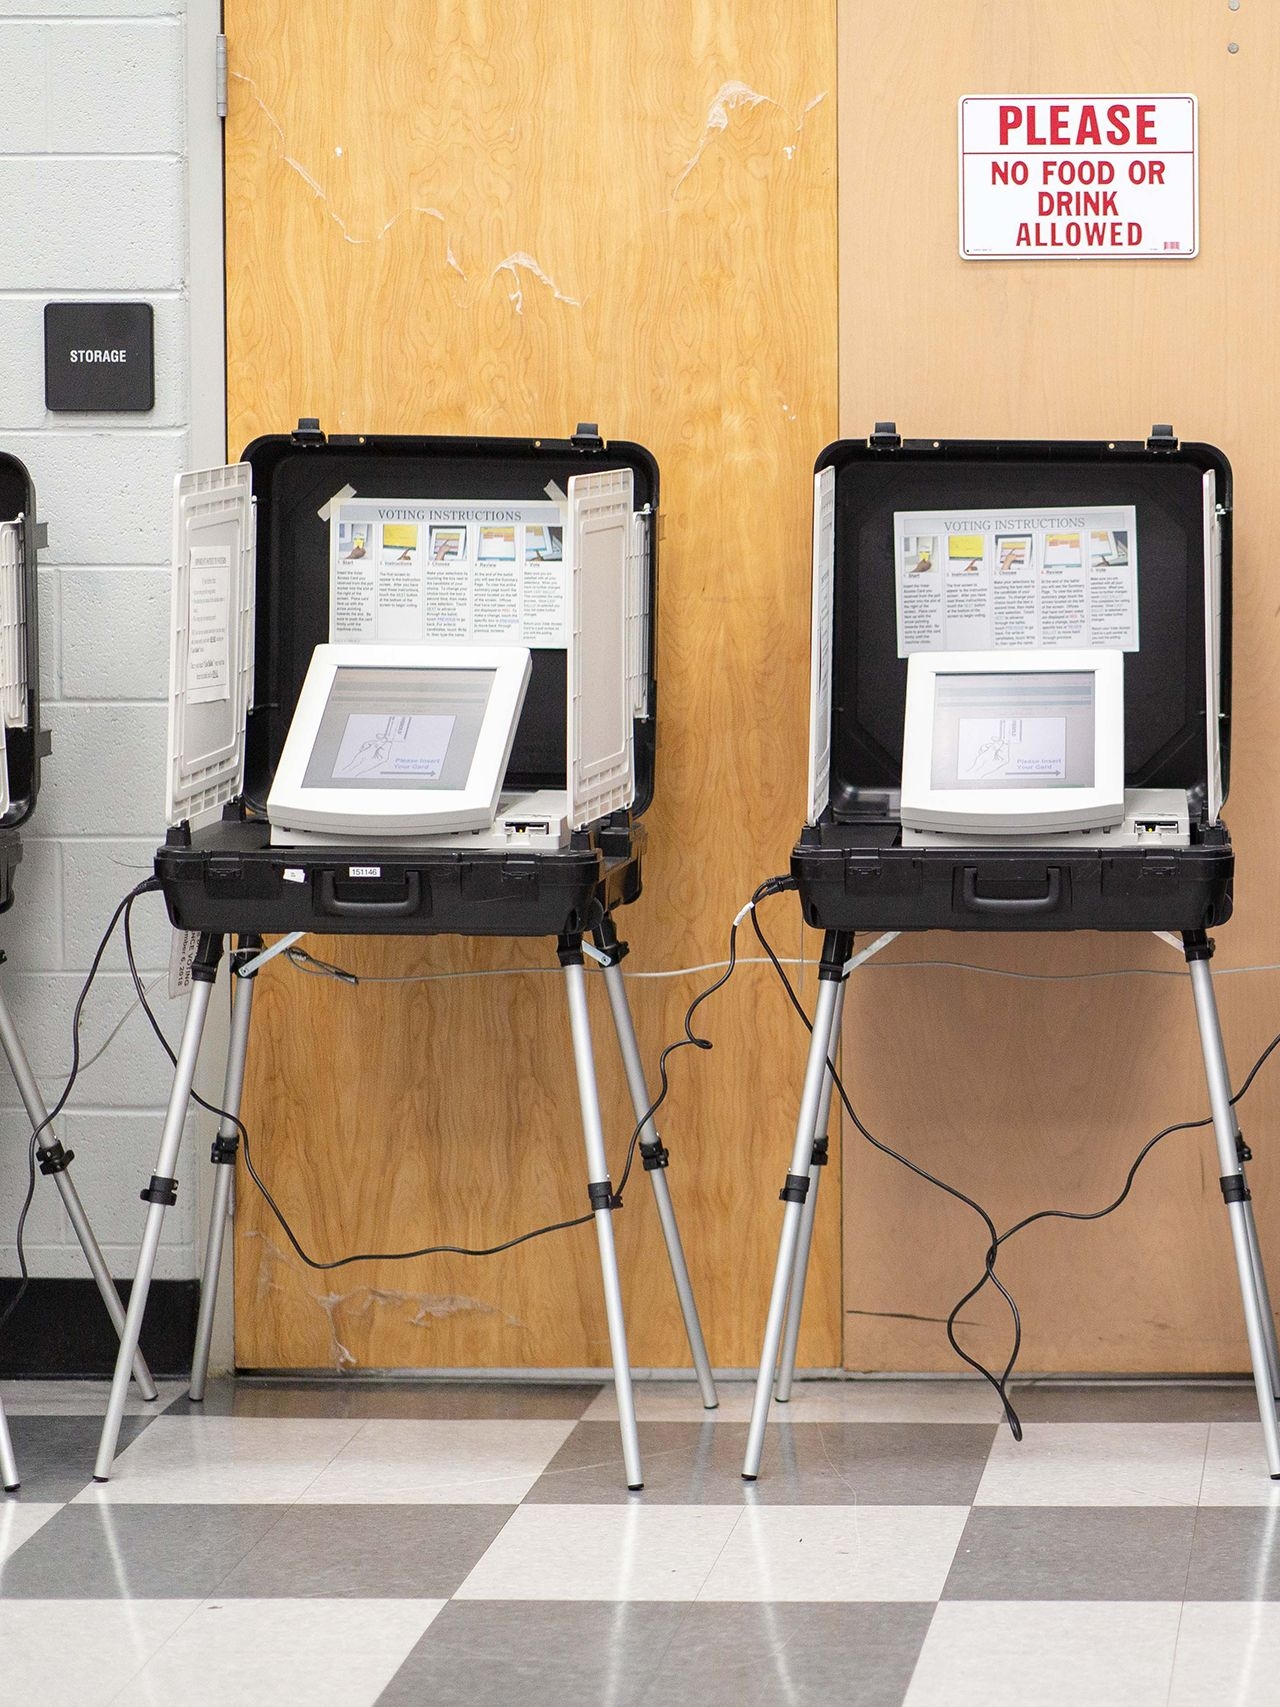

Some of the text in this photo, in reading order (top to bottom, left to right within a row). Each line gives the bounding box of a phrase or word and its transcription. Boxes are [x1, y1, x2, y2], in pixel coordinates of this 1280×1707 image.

[999, 104, 1158, 146] PLEASE
[991, 160, 1166, 186] NO FOOD OR
[1038, 190, 1119, 216] DRINK
[1016, 222, 1143, 246] ALLOWED
[70, 350, 127, 363] STORAGE
[378, 508, 522, 522] VOTING INSTRUCTIONS
[944, 518, 1086, 532] VOTING INSTRUCTIONS
[184, 952, 193, 986] VOTING
